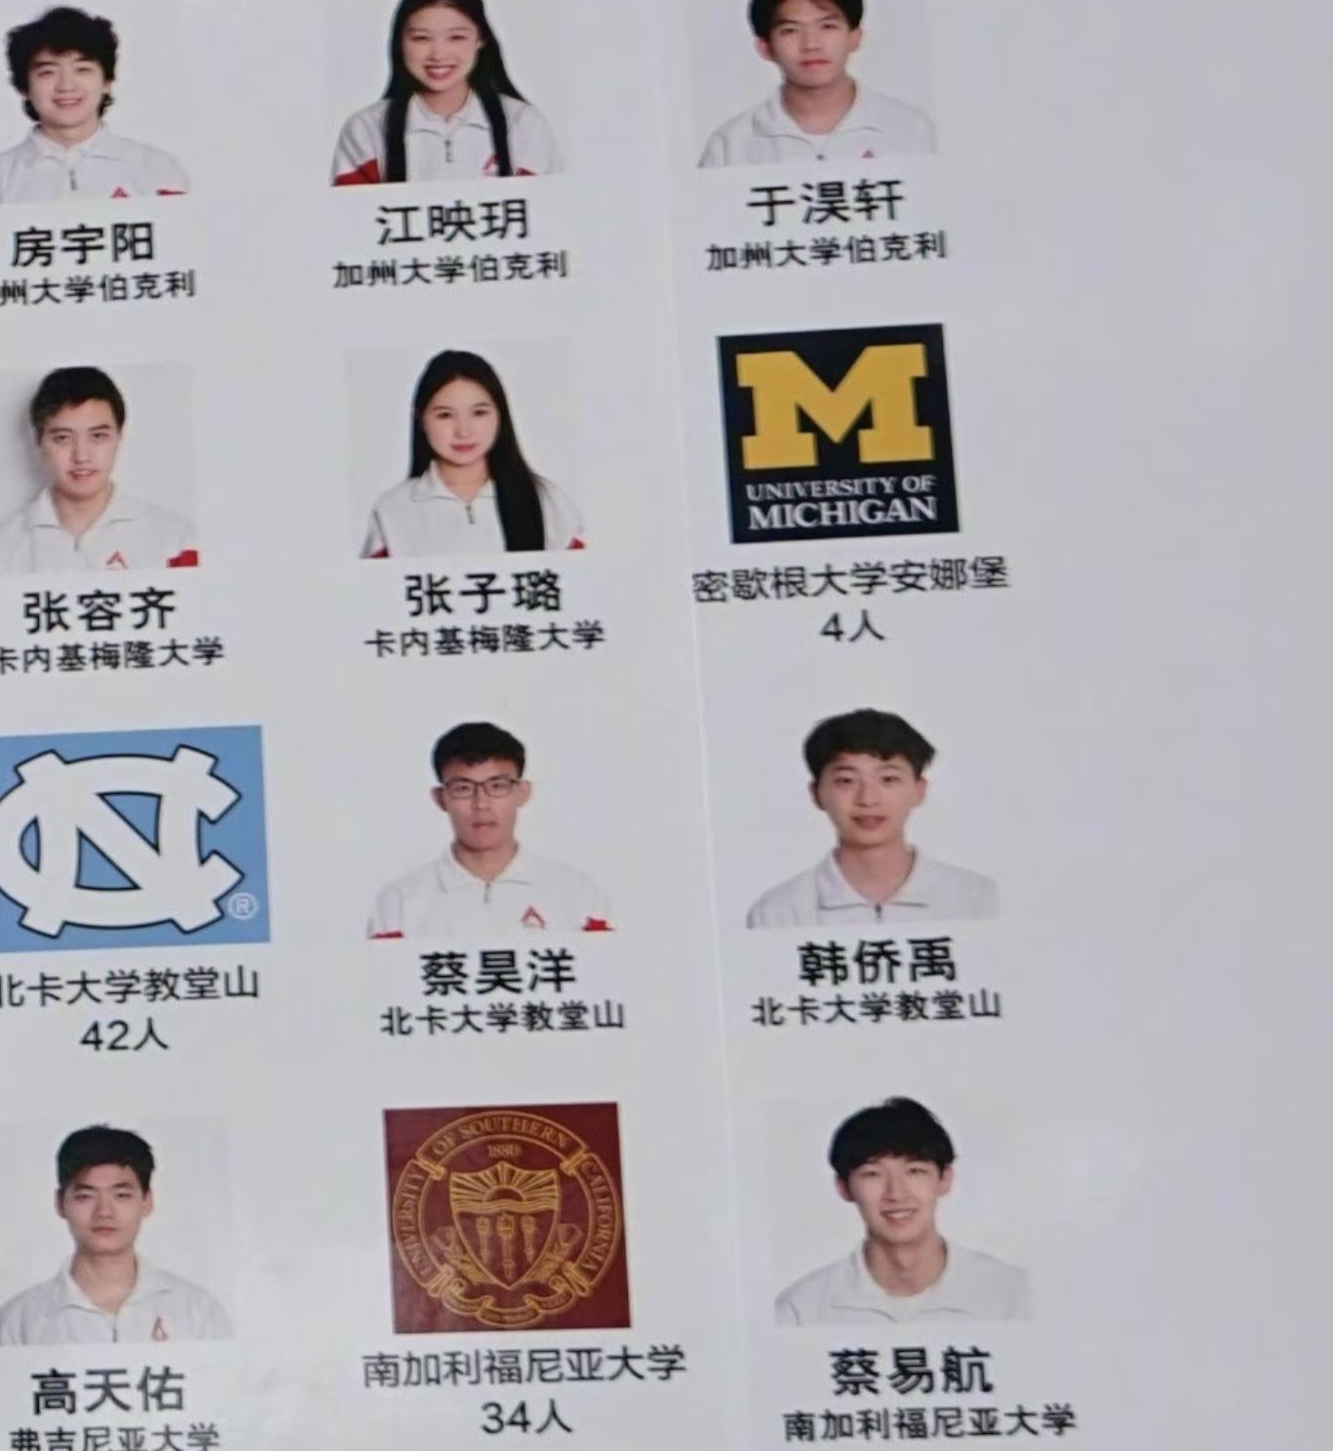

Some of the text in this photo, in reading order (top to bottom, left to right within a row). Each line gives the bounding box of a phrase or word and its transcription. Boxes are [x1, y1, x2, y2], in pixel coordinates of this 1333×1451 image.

[375, 198, 529, 247] 江映玥
[746, 178, 905, 228] 于淏轩
[10, 221, 155, 268] 房宇阳
[705, 230, 946, 271] 加州大学伯克利
[332, 250, 568, 289] 加州大学伯克利
[736, 343, 935, 470] M
[746, 474, 937, 501] UNIVERSITY OF
[747, 497, 939, 531] MICHIGAN
[404, 568, 562, 618] 张子璐
[691, 555, 1009, 603] 密歇根大学安娜堡
[22, 585, 176, 635] 张容齐
[819, 609, 886, 643] 4人
[364, 619, 605, 658] 卡内基梅隆大学
[419, 947, 577, 997] 蔡昊洋
[796, 935, 957, 988] 韩侨禹
[380, 999, 625, 1036] 北卡大学教堂山
[751, 988, 1002, 1027] 北卡大学教堂山
[79, 1016, 170, 1052] 42人
[362, 1344, 687, 1388] 南加利福尼亚大学
[828, 1345, 995, 1397] 蔡易航
[30, 1365, 185, 1416] 高天佑
[481, 1398, 573, 1435] 34人
[782, 1403, 1076, 1443] 南加利福尼亚大学
